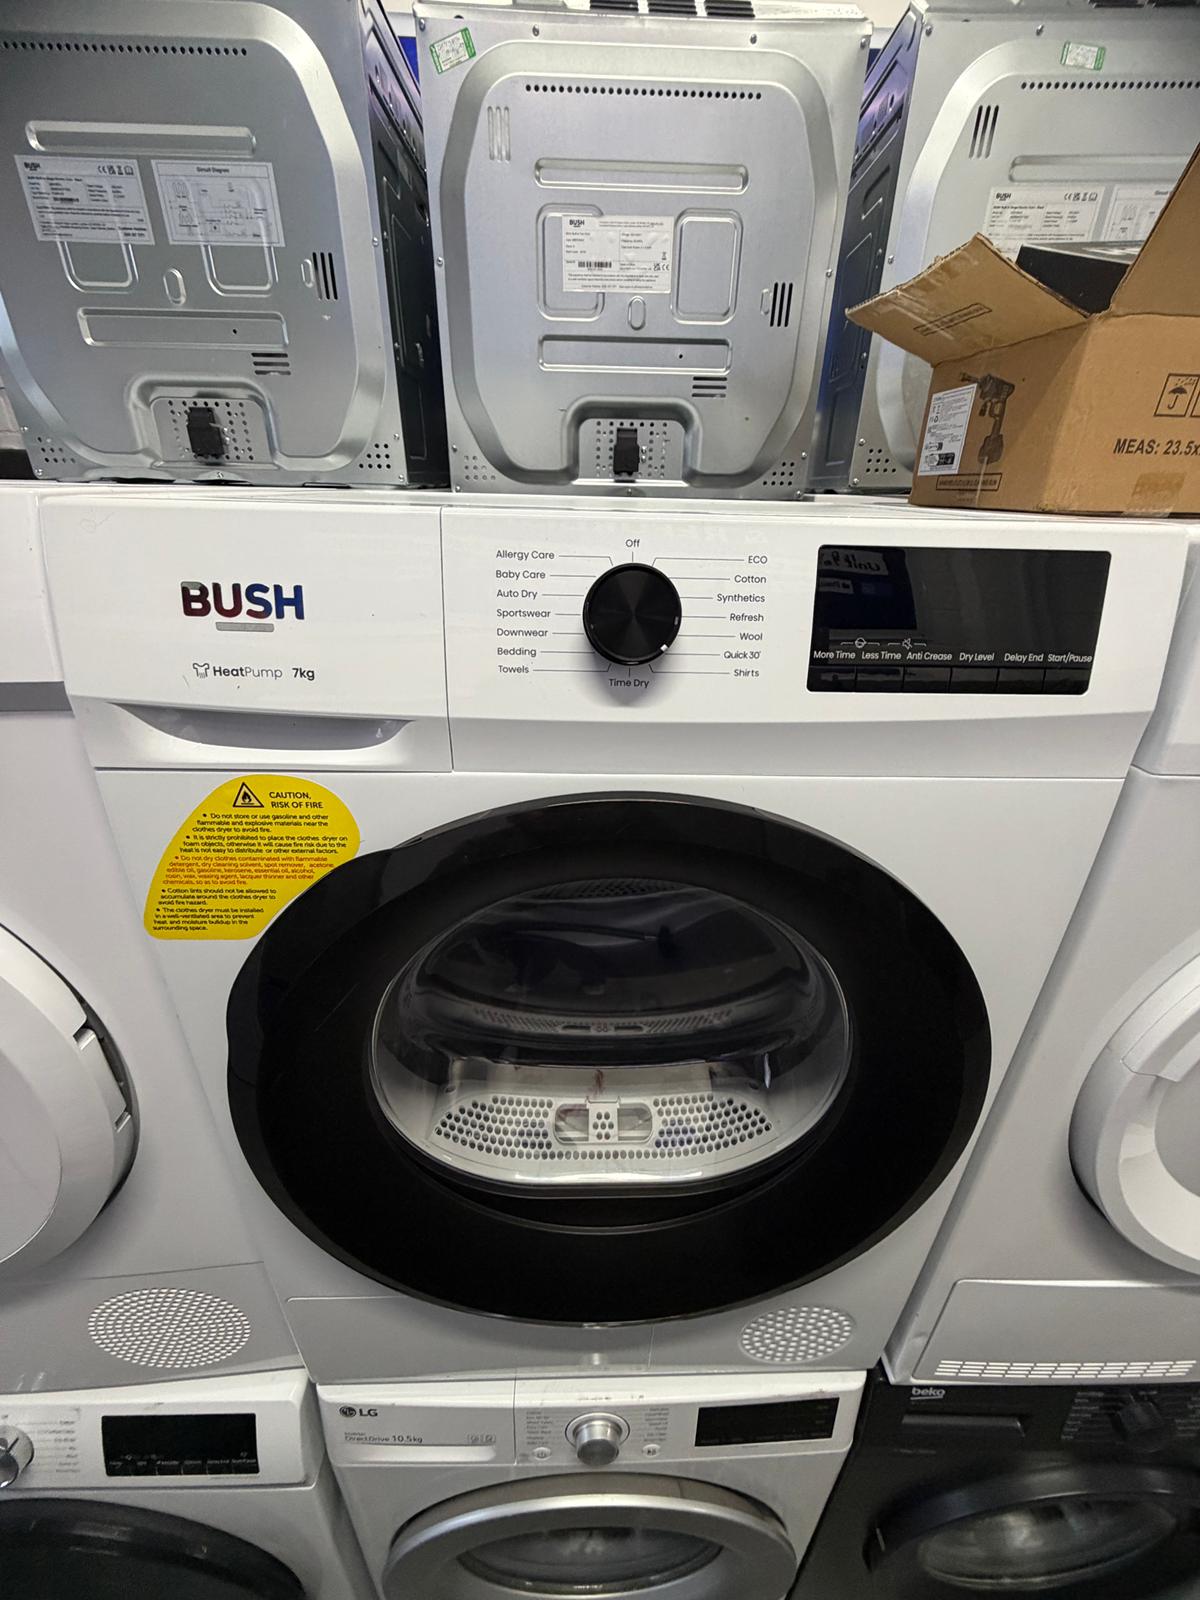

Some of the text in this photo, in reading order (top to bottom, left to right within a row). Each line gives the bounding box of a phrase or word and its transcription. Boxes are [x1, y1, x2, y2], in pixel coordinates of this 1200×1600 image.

[1113, 438, 1200, 456] MEAS: 23.5x
[625, 539, 640, 548] Off
[496, 550, 555, 561] Allergy Care
[748, 556, 768, 564] ECO
[496, 570, 546, 580] Baby Care
[734, 574, 766, 584] Cotton
[496, 589, 538, 600] Auto Dry
[717, 593, 765, 604] Synthetics
[180, 581, 304, 620] BUSH
[496, 608, 551, 619] Sportswear
[730, 612, 764, 622] Refresh
[496, 628, 548, 637] Downwear
[740, 632, 762, 641] Wool
[497, 648, 537, 658] Bedding
[724, 650, 748, 660] Quick
[813, 651, 856, 659] More Time
[861, 651, 902, 660] Less Time
[906, 652, 952, 660] Anti Crease
[959, 652, 994, 662] Dry Level
[1004, 653, 1044, 663] Delay End
[1048, 652, 1092, 663] Start/Pause
[212, 666, 316, 681] HeatPump 7kg
[498, 664, 530, 674] Towels
[734, 668, 760, 678] Shirts
[609, 678, 650, 688] Time Dry
[269, 792, 312, 800] CAUTION,
[911, 1386, 946, 1398] beko
[359, 1408, 378, 1417] LG
